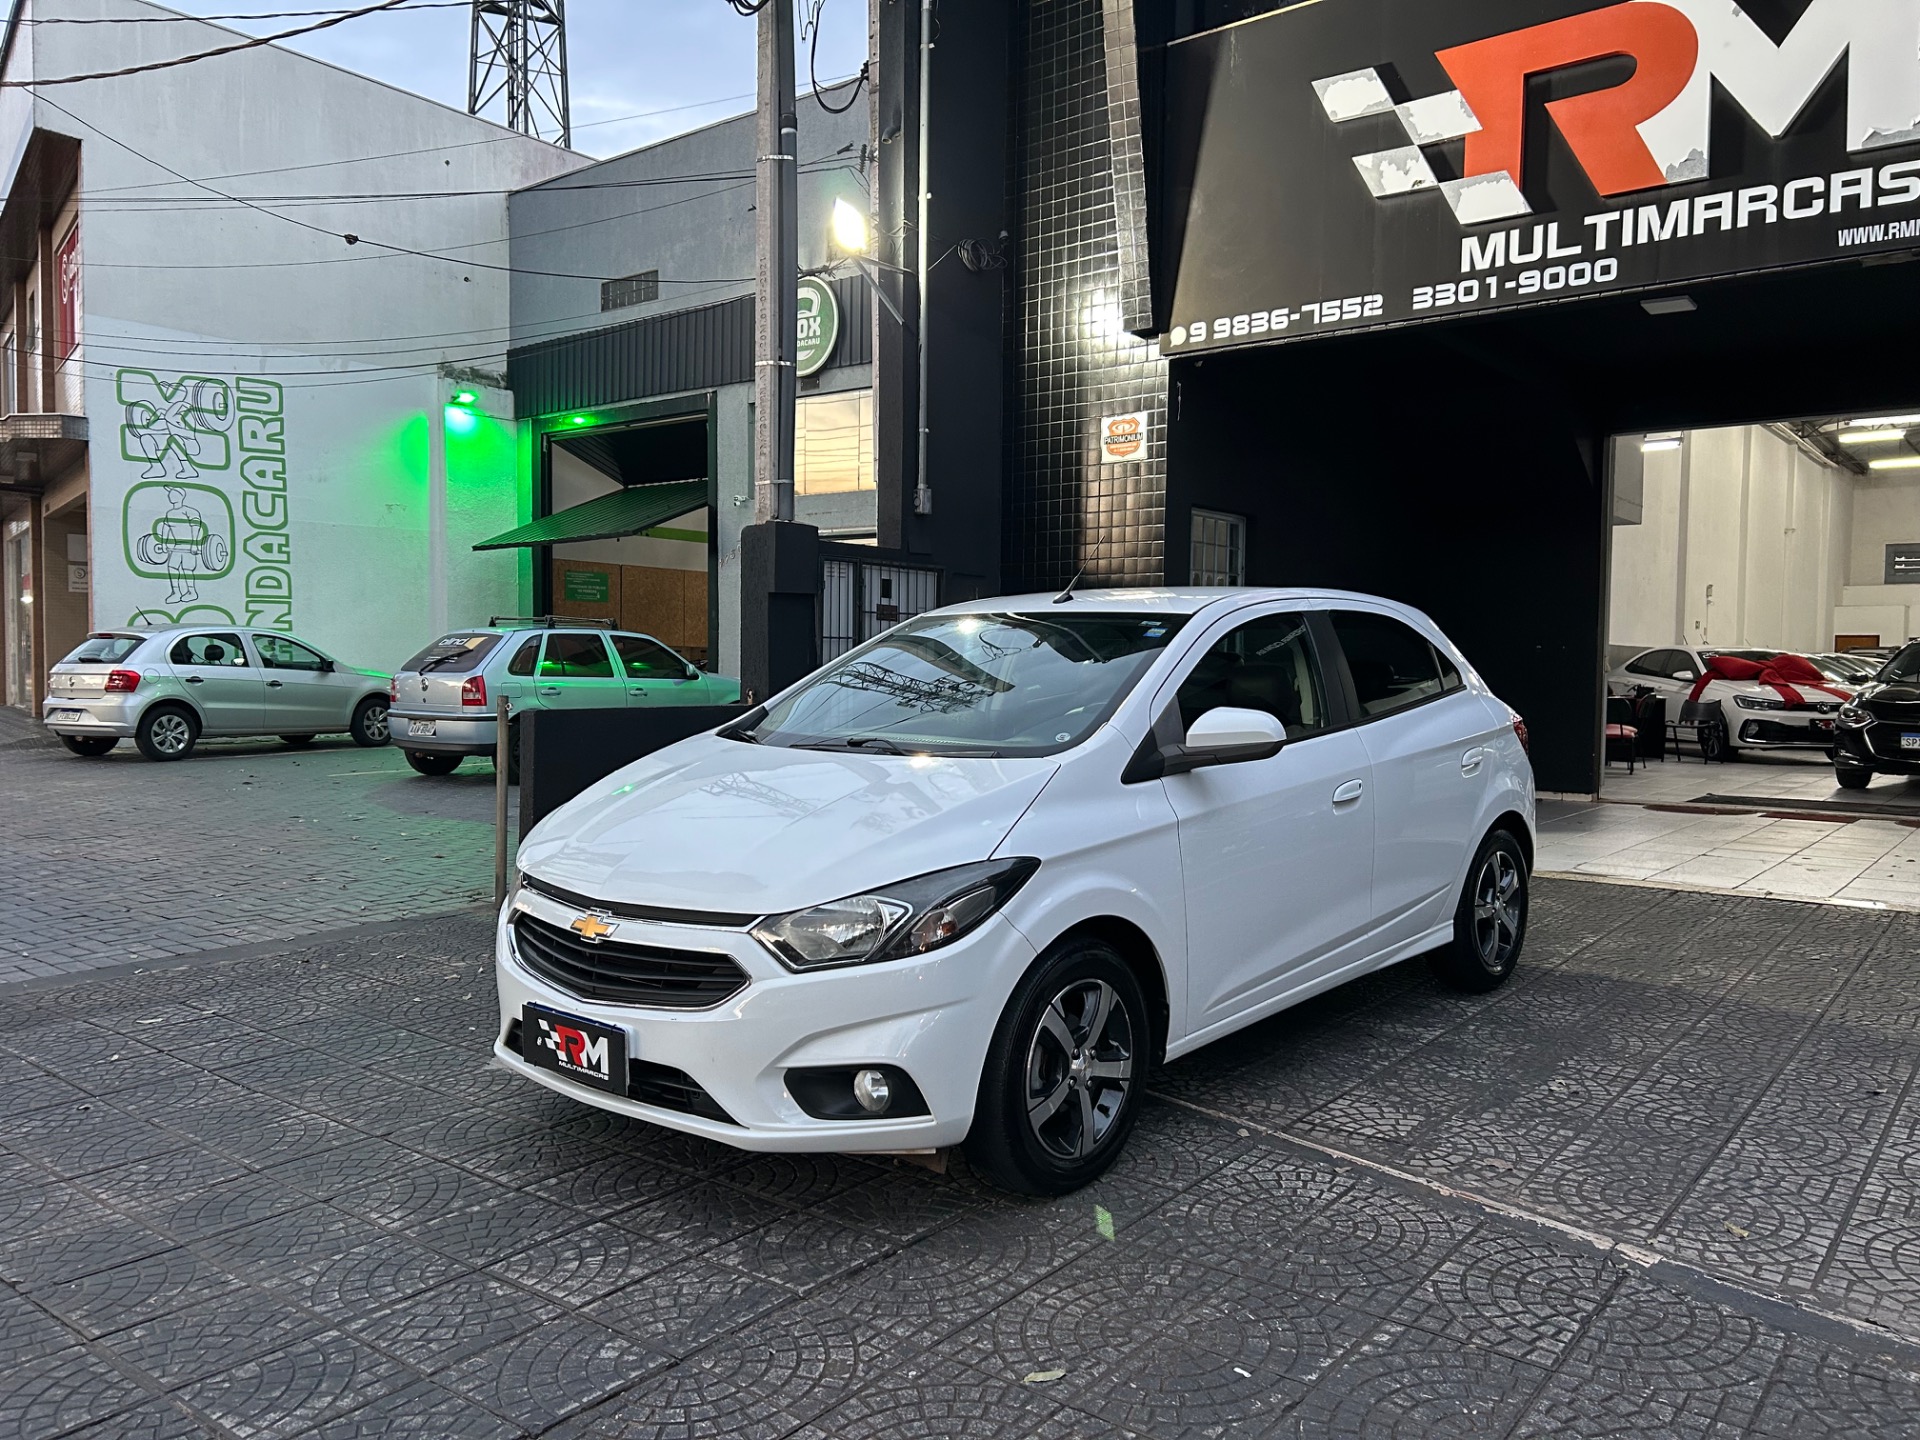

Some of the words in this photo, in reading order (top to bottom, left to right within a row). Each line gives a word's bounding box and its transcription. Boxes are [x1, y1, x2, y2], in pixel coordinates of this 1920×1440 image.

[1435, 0, 1920, 198] RM
[1460, 159, 1920, 273] MULTIMARCAS
[1189, 321, 1207, 343] 9
[1213, 294, 1383, 340] 9836-7552
[1412, 257, 1618, 310] 3301-9000
[797, 316, 821, 338] OX
[797, 337, 820, 347] DACARU
[116, 368, 236, 628] OX
[1905, 738, 1920, 747] SP
[554, 1024, 609, 1074] RM
[559, 1061, 609, 1081] MULTIMARCAS
